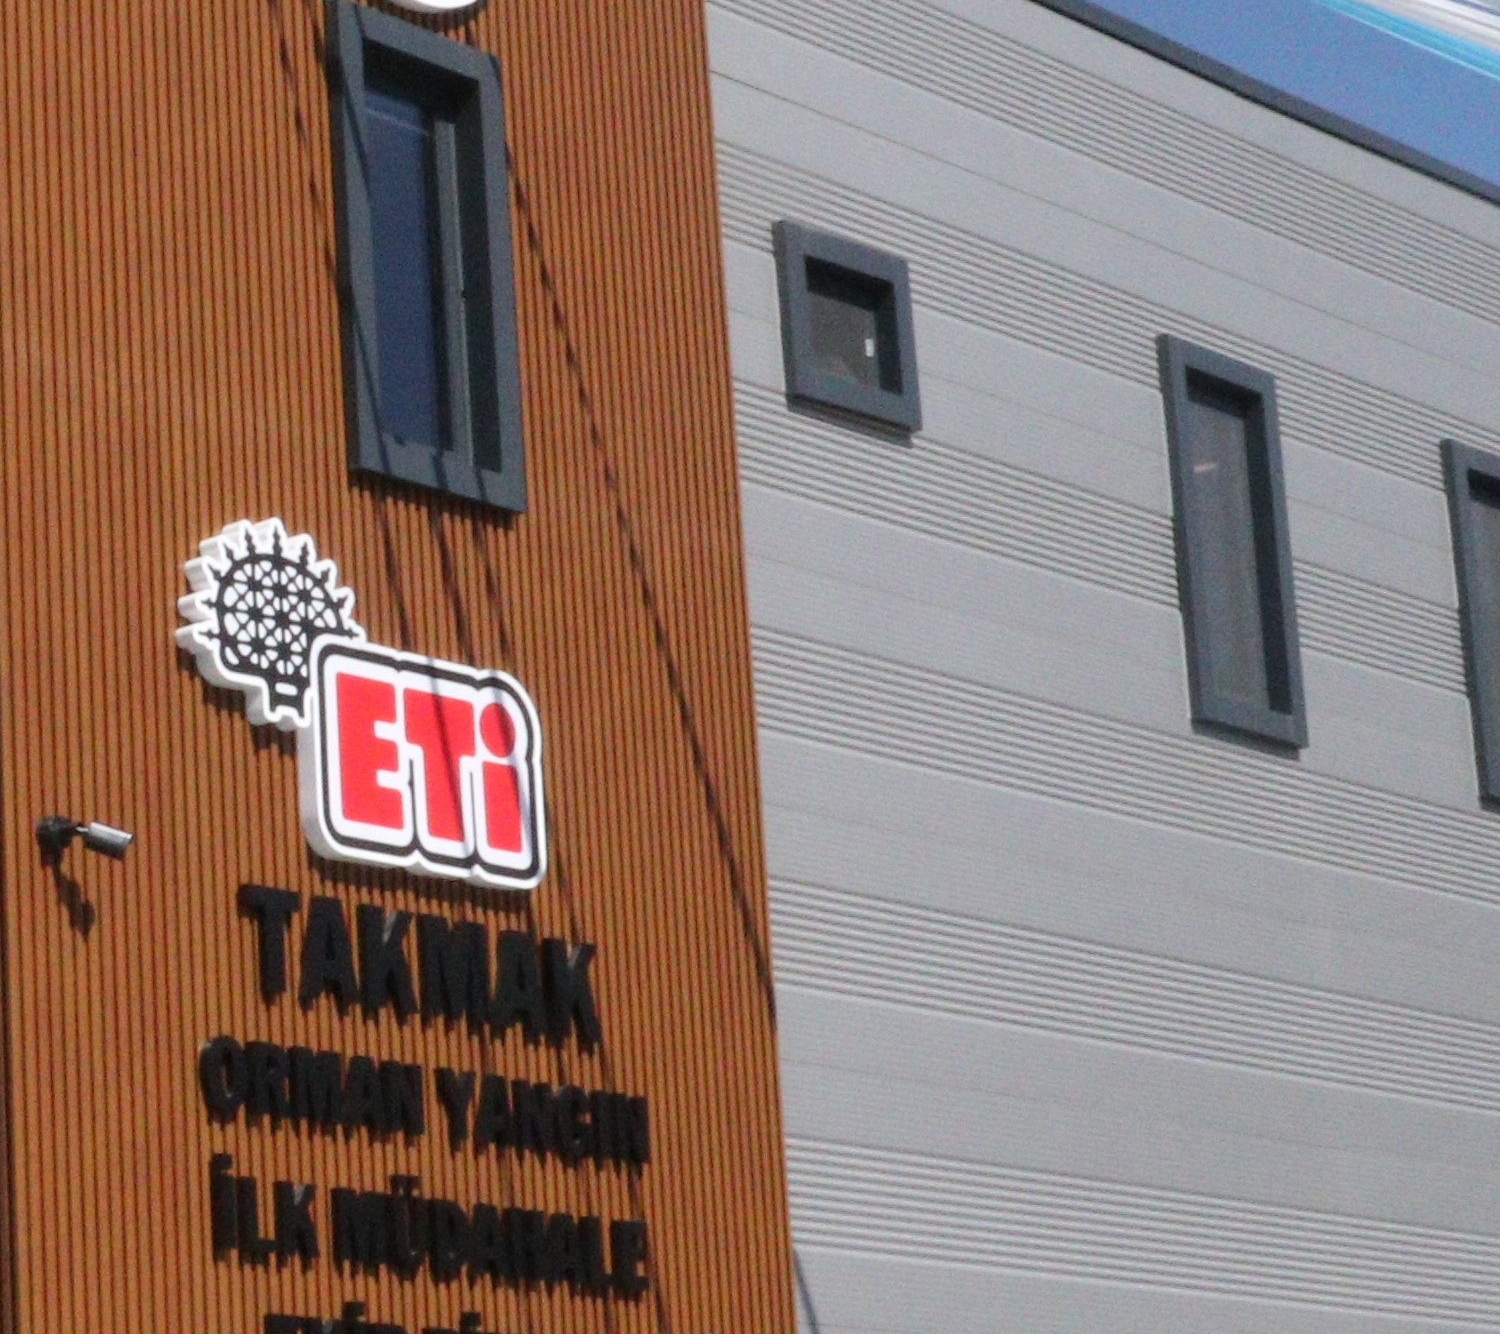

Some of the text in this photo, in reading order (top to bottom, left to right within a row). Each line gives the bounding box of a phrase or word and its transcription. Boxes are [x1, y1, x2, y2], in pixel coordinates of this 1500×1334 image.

[237, 884, 602, 1053] TAKMAK
[200, 1035, 651, 1175] ORMAN YANGIN
[330, 1174, 650, 1299] MÜDAHALE
